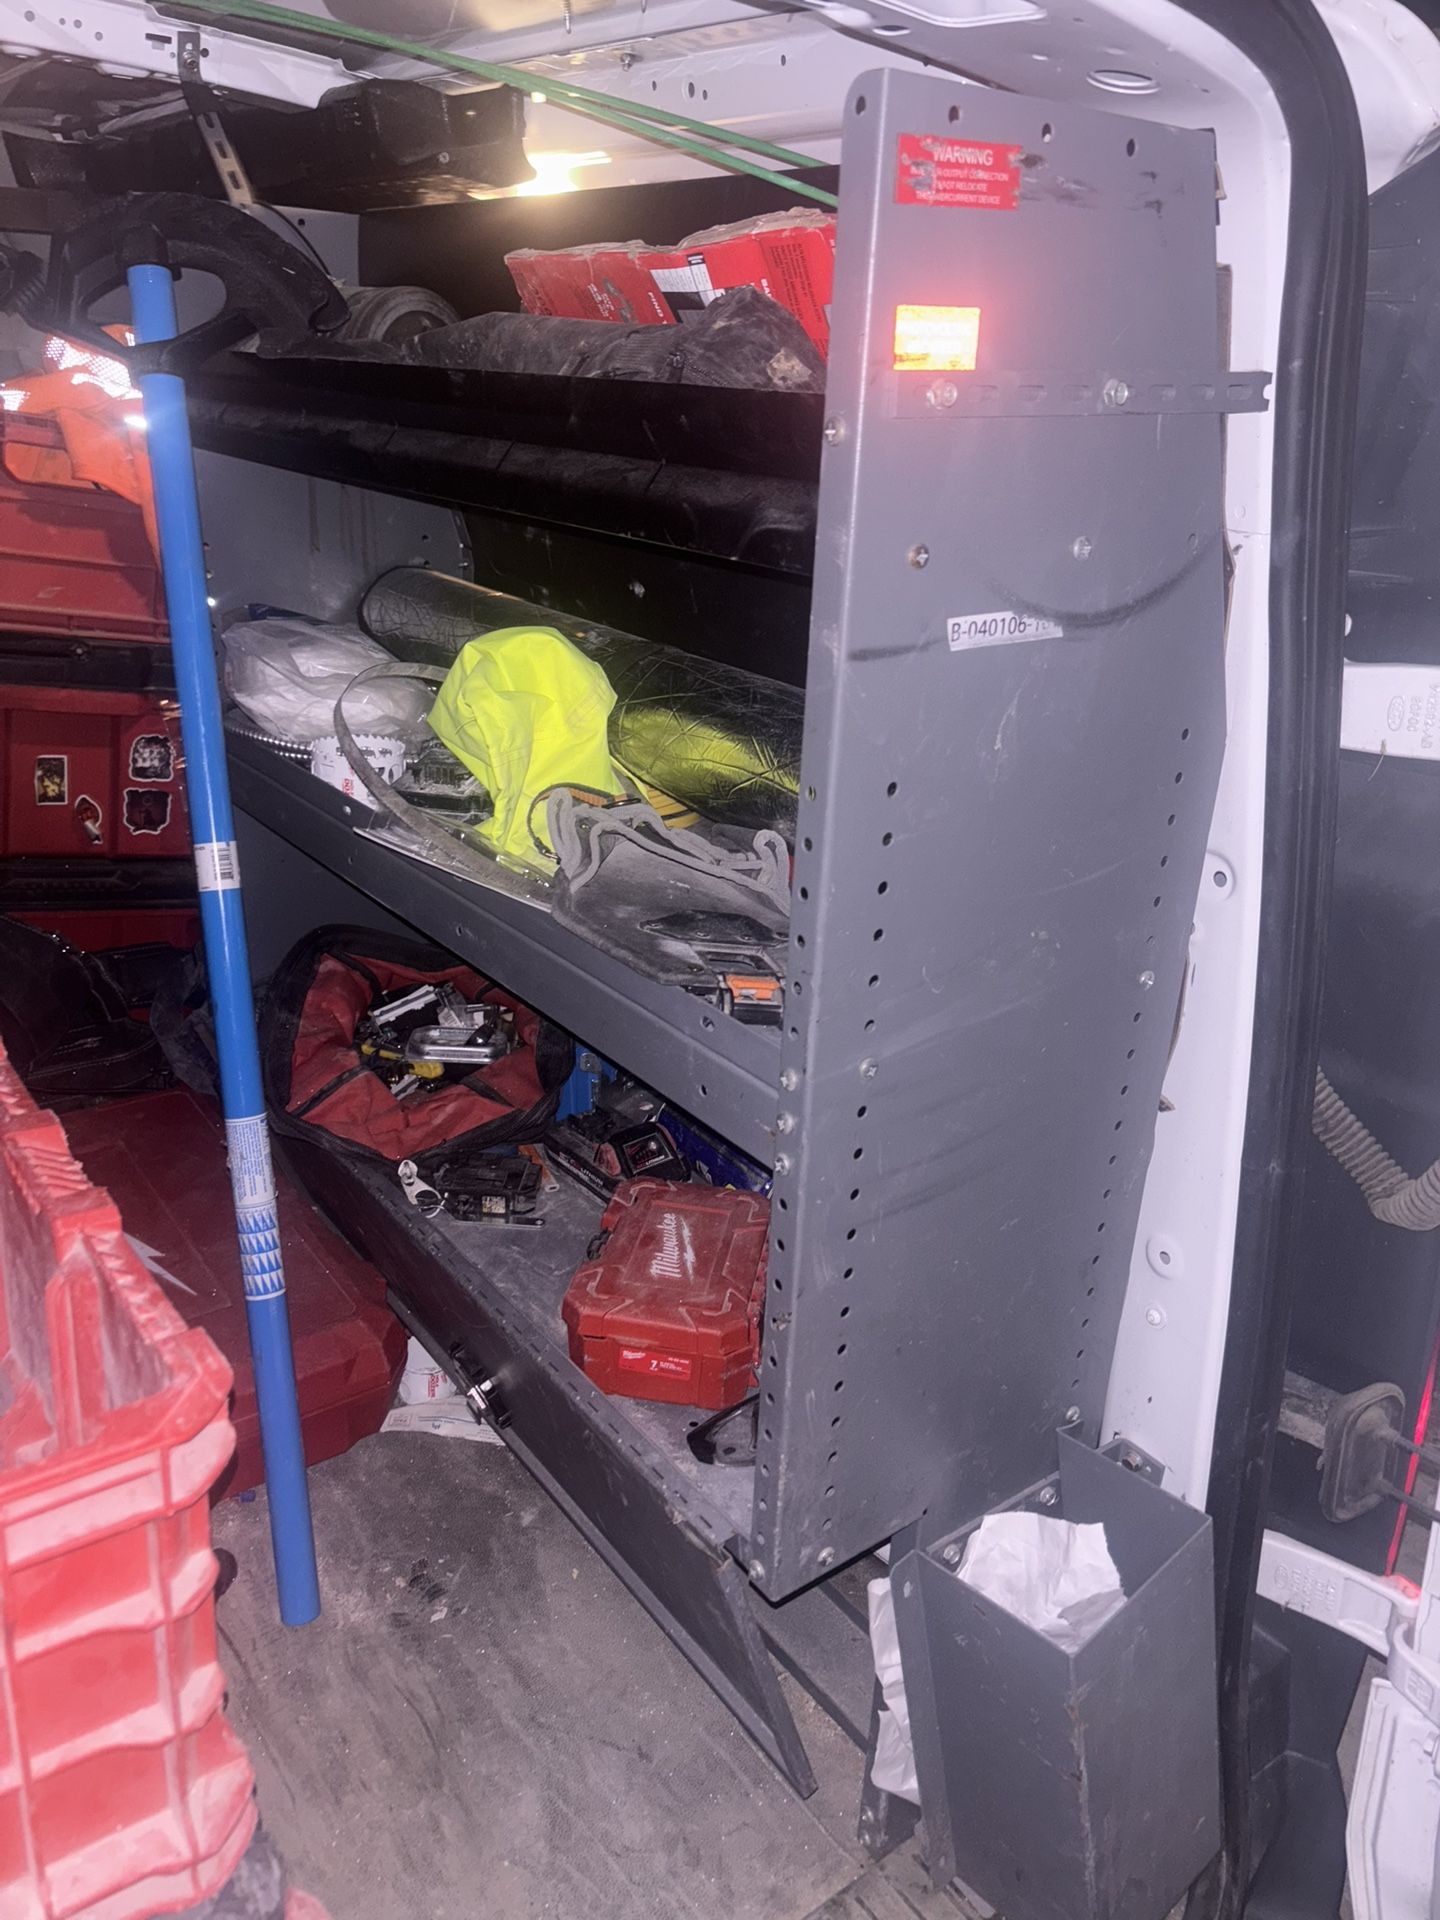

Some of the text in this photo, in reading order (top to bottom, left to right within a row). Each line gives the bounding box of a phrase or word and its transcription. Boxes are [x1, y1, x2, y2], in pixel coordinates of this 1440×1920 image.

[933, 145, 994, 166] WARNING
[955, 181, 988, 193] RELOCATE
[648, 1212, 682, 1279] Milwaukee
[650, 1359, 658, 1368] 7
